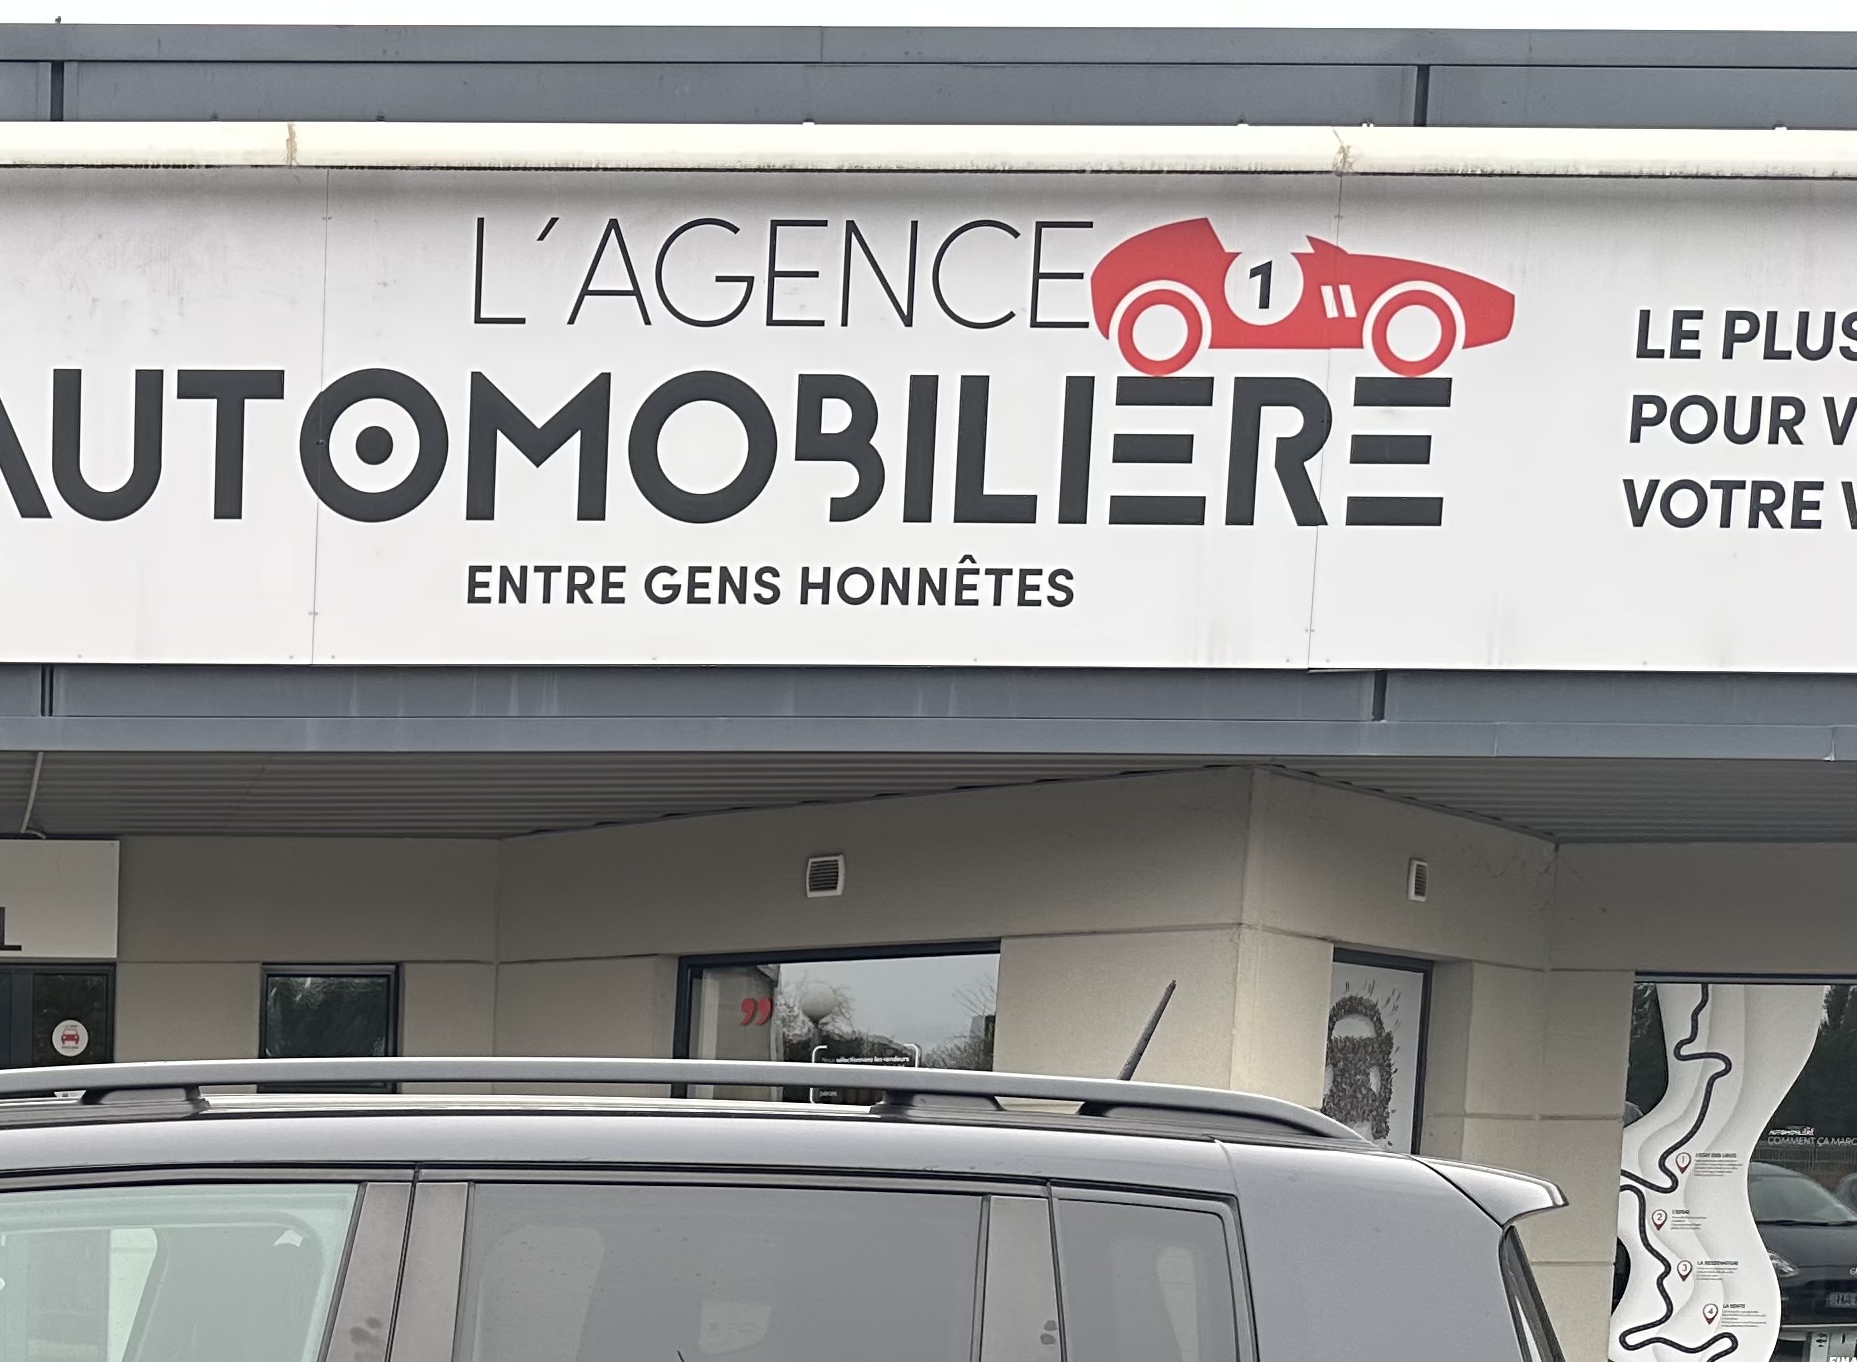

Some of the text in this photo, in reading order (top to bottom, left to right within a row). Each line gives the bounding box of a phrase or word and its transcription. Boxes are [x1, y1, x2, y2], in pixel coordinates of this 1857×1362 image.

[1248, 258, 1273, 310] 1
[1636, 309, 1704, 359] LE
[1629, 394, 1806, 445] POUR
[1622, 478, 1825, 530] VOTRE
[467, 554, 1076, 608] ENTRE GENS HONNÊTES
[1656, 1213, 1663, 1221] 2
